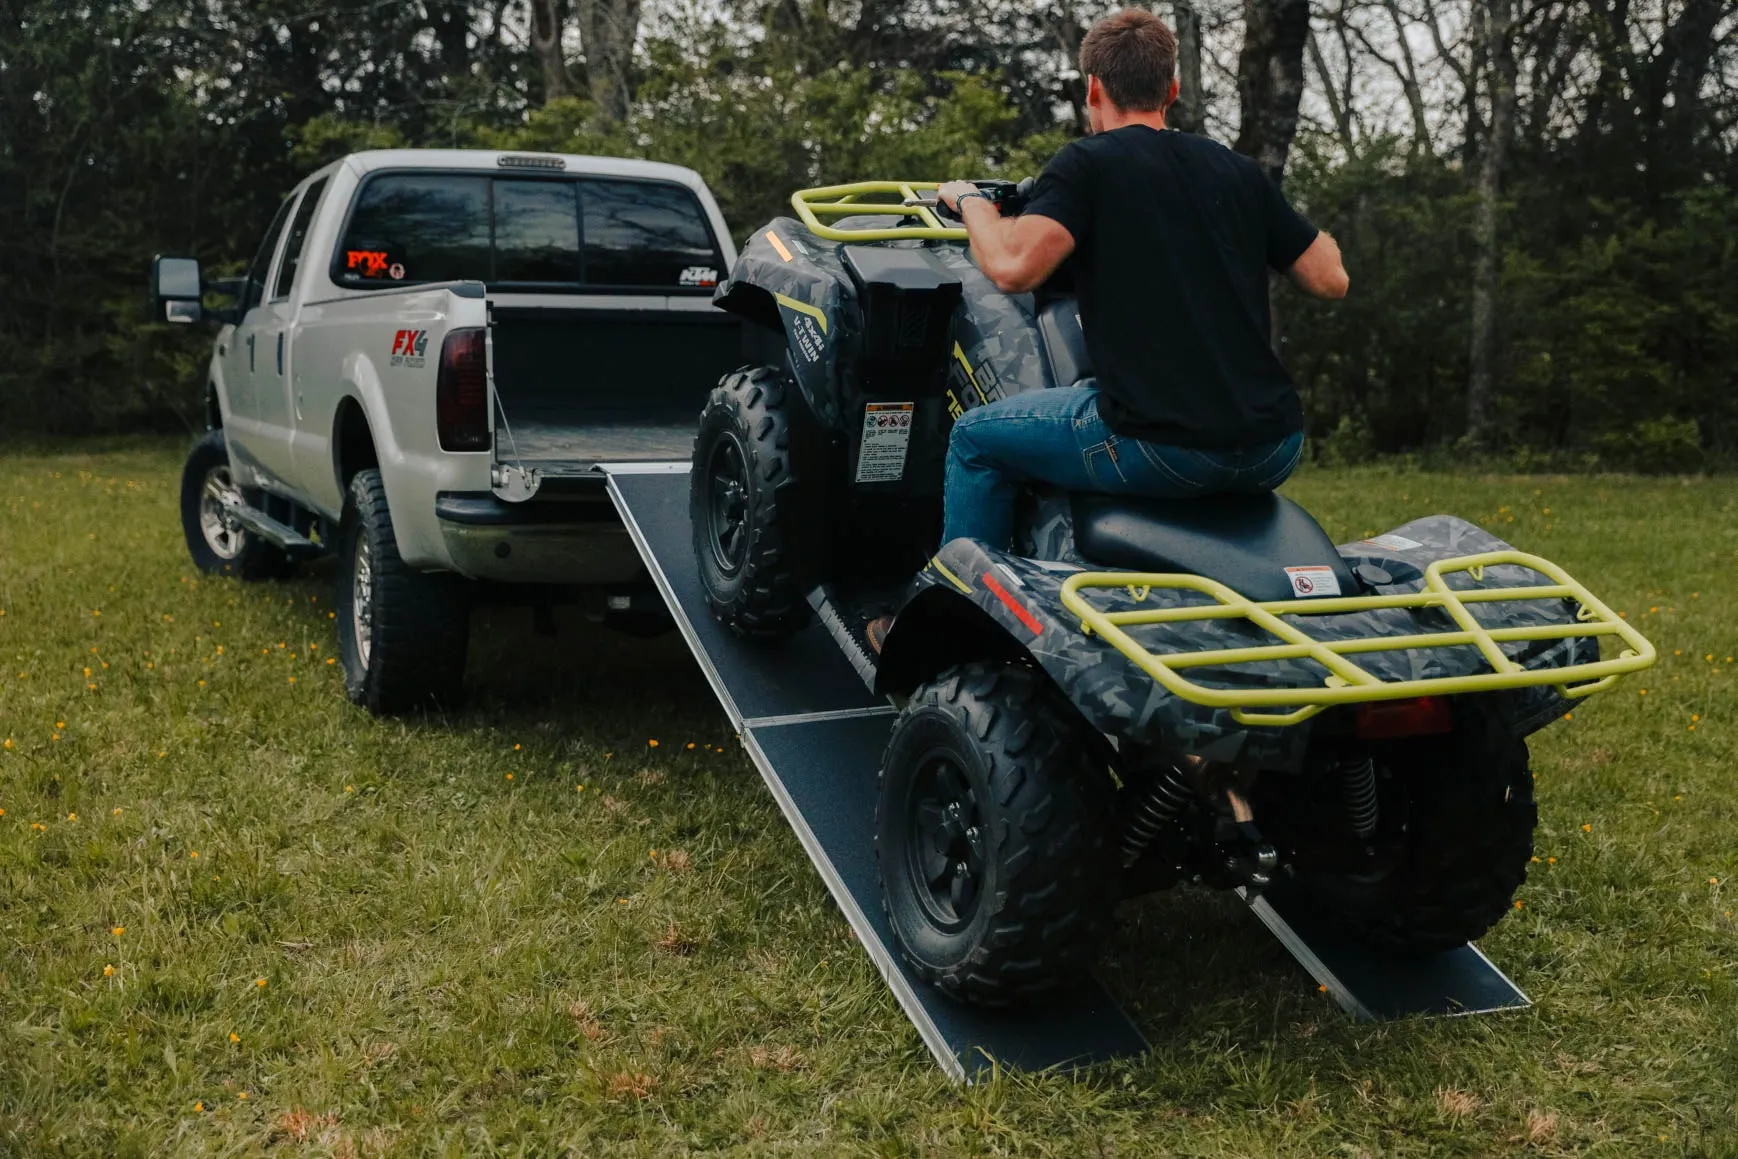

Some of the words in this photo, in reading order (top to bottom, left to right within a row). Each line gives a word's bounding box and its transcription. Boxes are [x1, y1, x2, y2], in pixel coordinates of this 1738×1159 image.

[347, 251, 388, 269] FOX
[392, 330, 428, 356] FX4
[794, 316, 819, 362] V-TWIN
